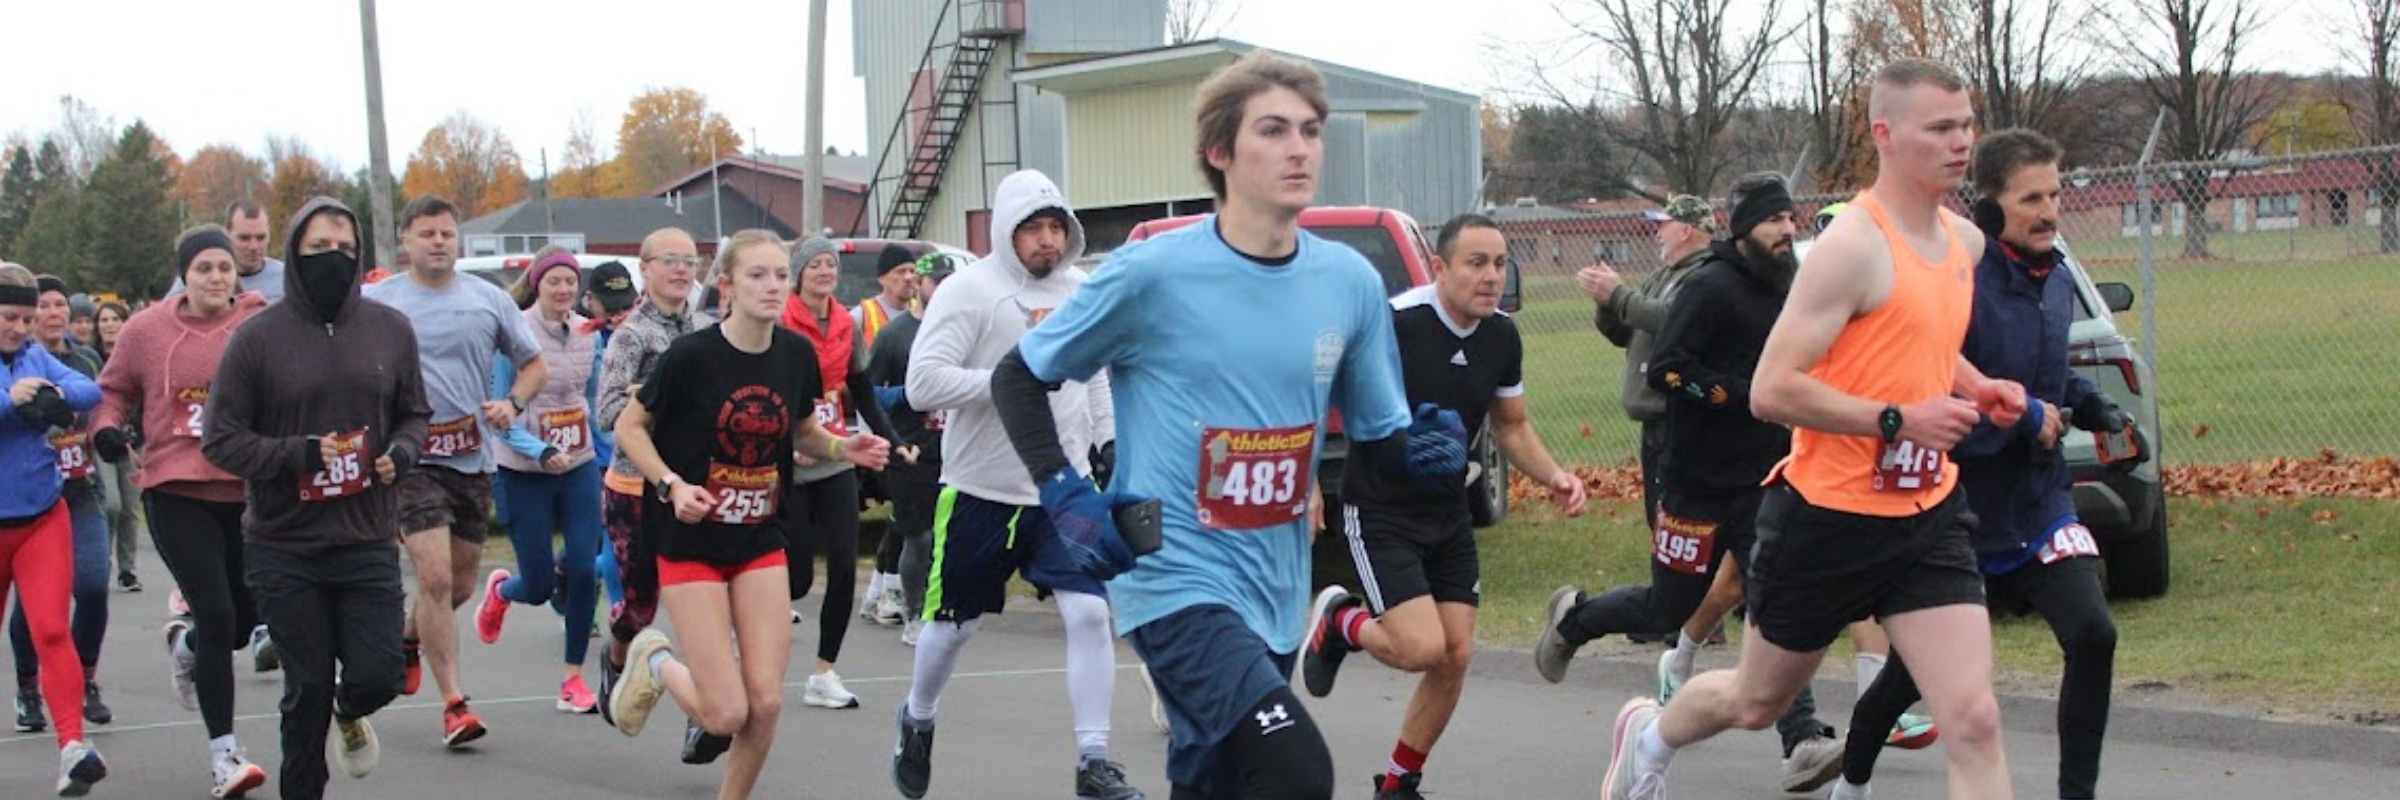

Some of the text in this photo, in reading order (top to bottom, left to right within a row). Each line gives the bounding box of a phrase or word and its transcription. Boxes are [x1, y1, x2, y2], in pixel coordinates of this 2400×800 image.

[815, 402, 834, 424] 53
[429, 432, 467, 454] 281
[55, 446, 83, 470] 93
[1223, 459, 1298, 505] 483
[716, 487, 769, 517] 255
[1659, 530, 1700, 561] 195
